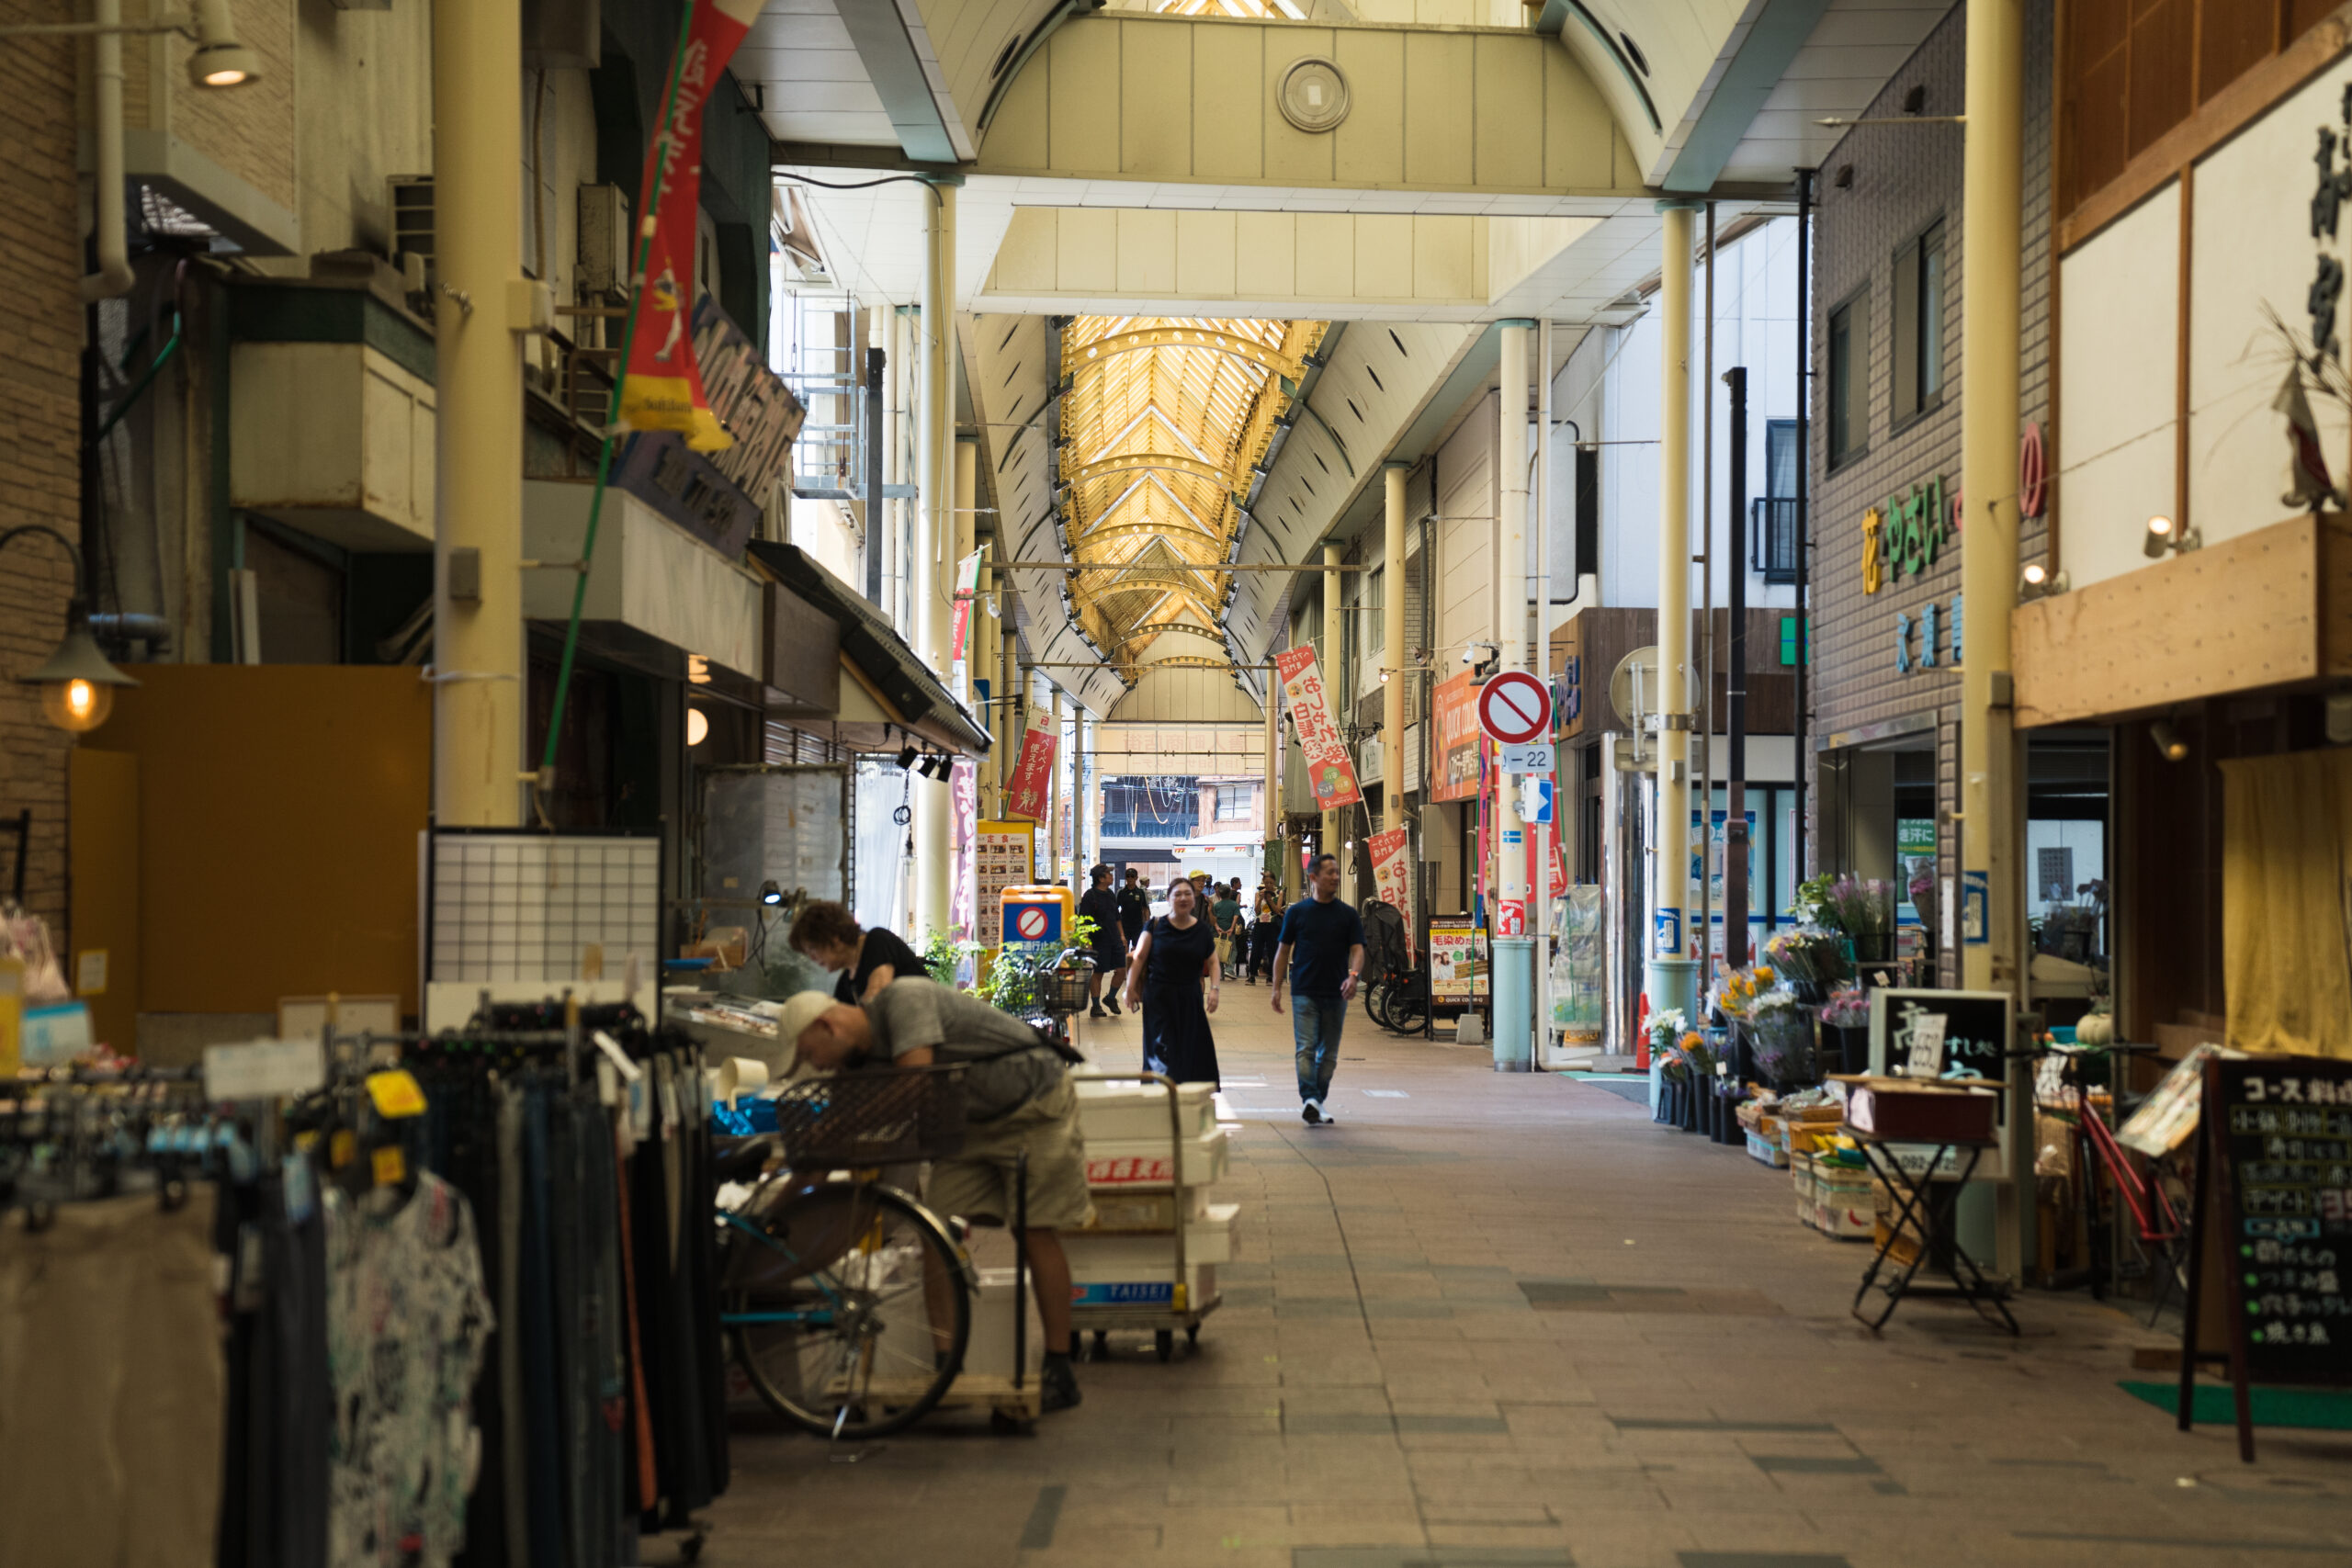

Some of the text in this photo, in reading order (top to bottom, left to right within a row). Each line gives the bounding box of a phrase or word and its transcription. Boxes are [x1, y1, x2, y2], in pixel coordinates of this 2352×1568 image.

[1446, 705, 1462, 746] QUICK
[1036, 738, 1050, 773] ペイペイ
